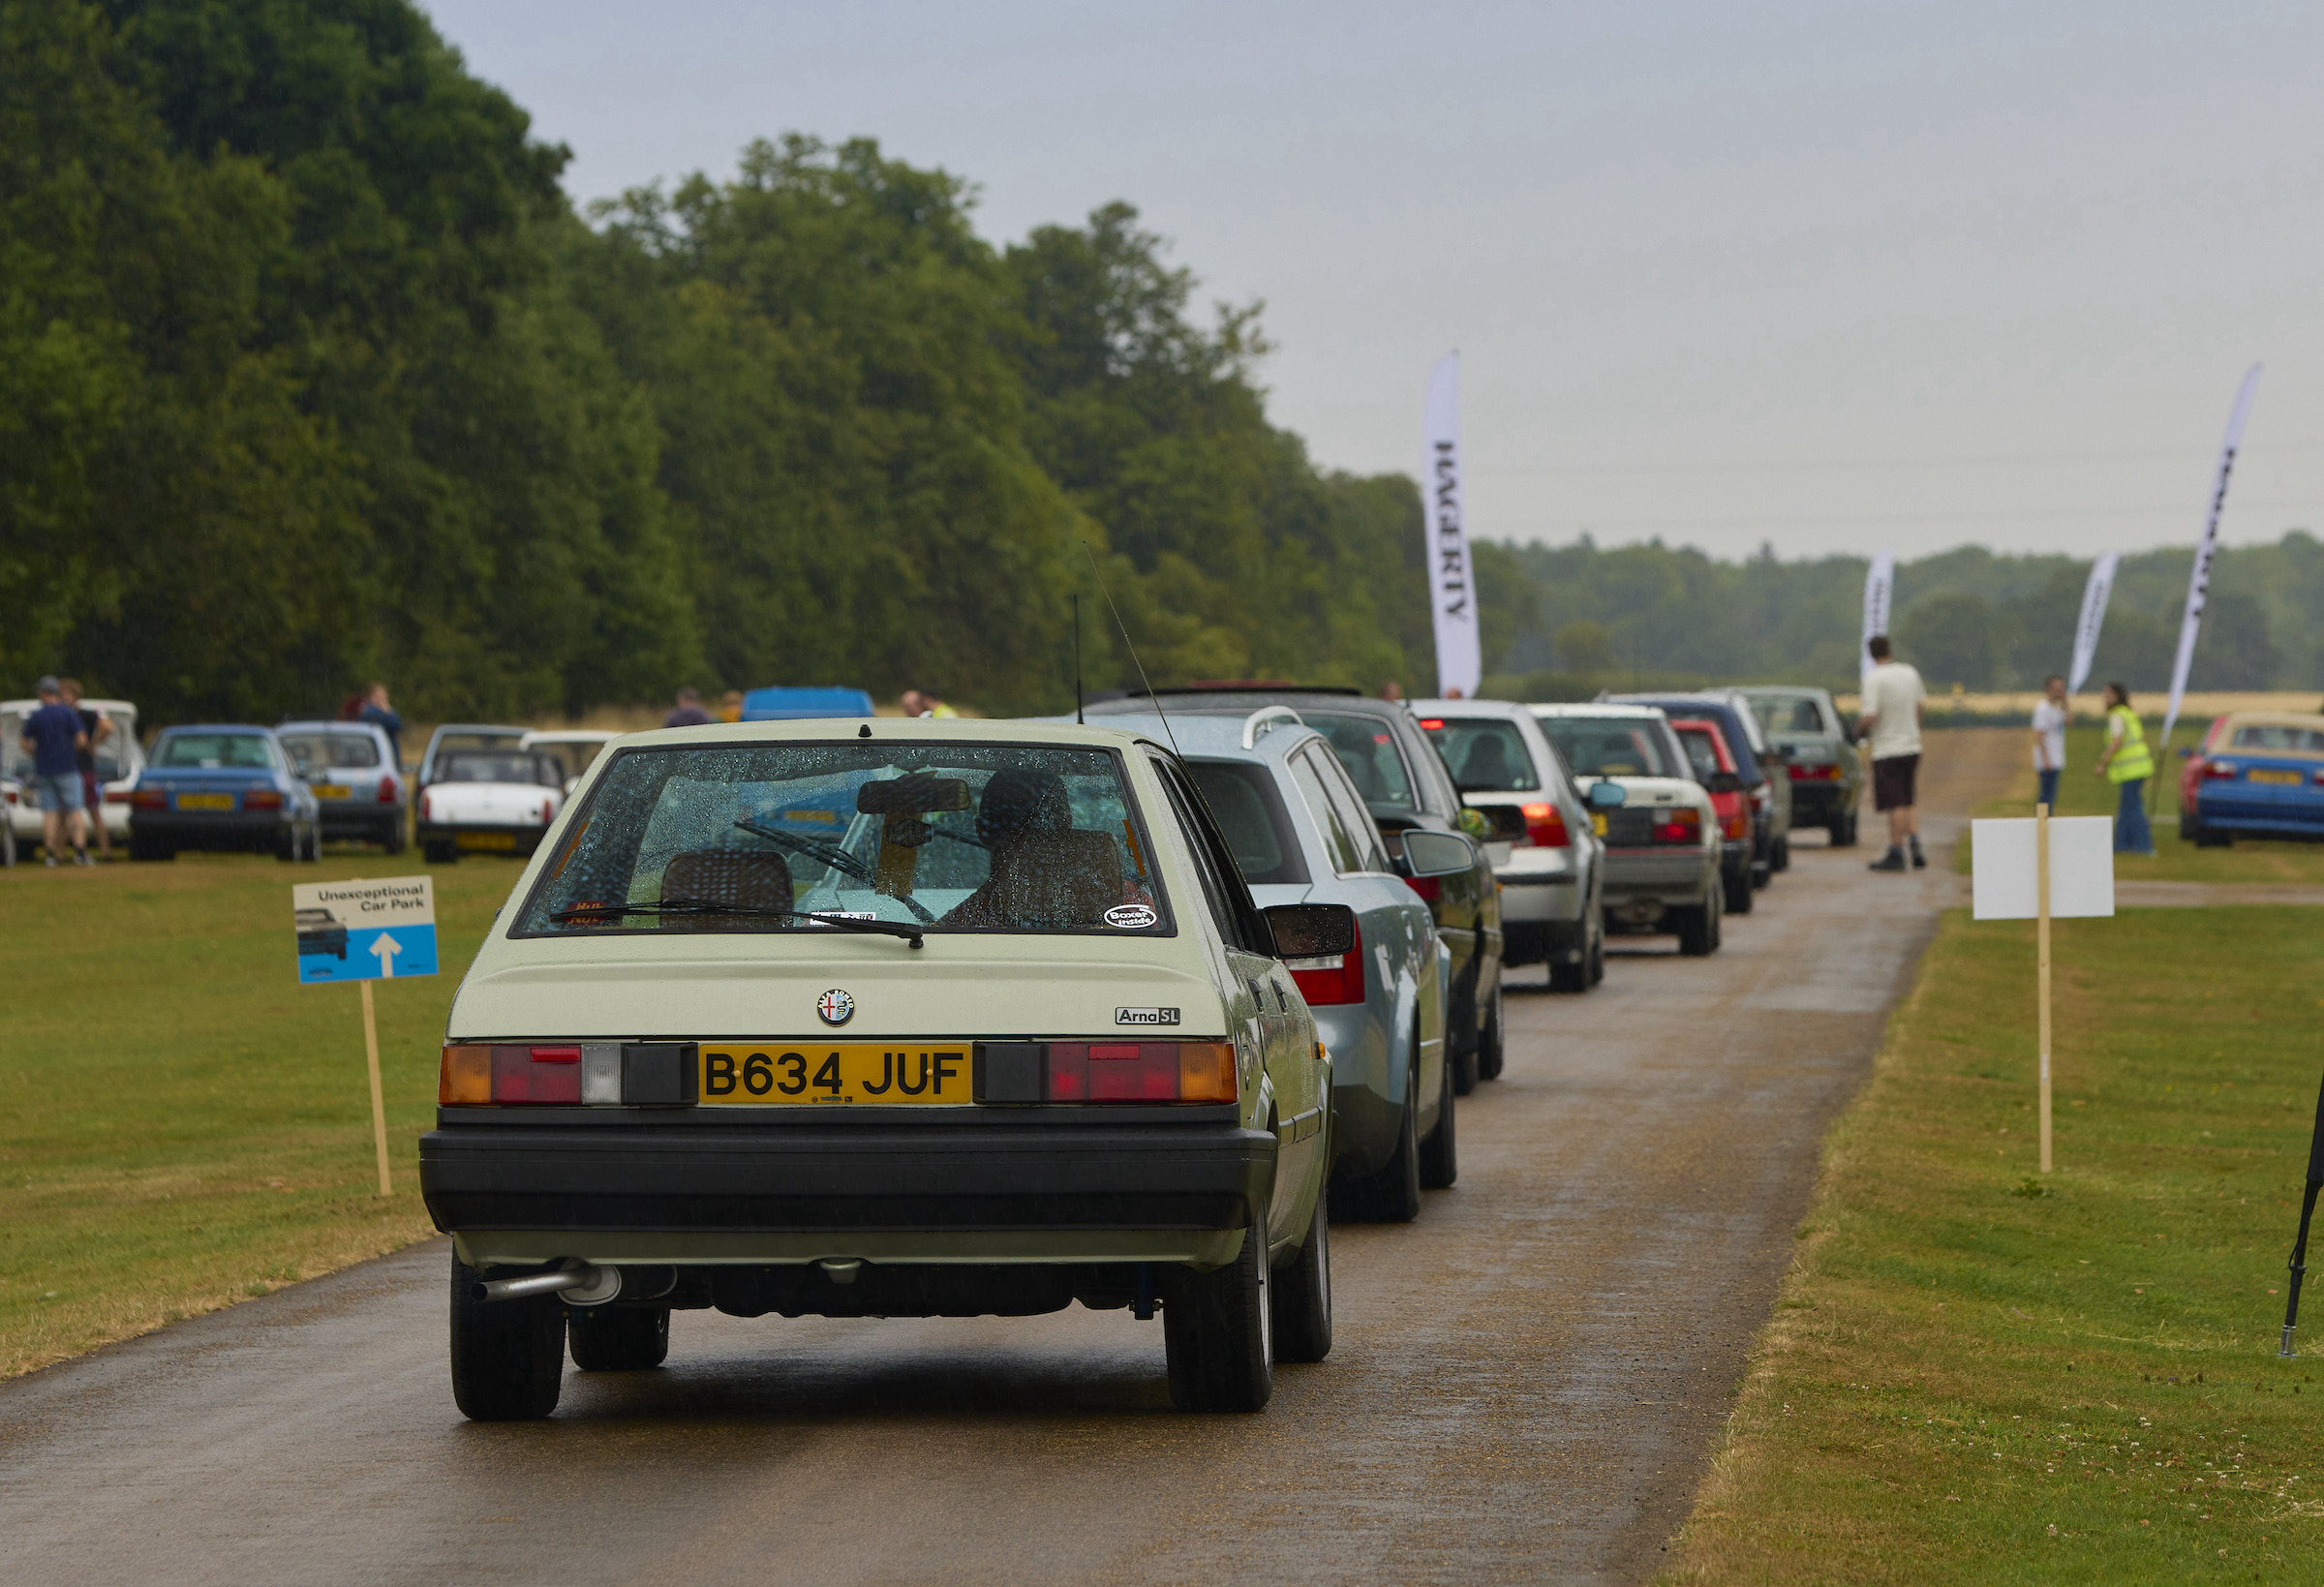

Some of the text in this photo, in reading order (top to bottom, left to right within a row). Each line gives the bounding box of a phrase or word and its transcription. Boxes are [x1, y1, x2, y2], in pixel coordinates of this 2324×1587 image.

[1435, 439, 1469, 623] HAGERTY
[319, 883, 424, 901] Unexceptional
[360, 898, 425, 912] Car Park
[1110, 911, 1148, 920] Boxer
[817, 990, 854, 1009] ALFA ROMEO
[1118, 1009, 1157, 1022] Arna
[705, 1052, 964, 1095] B634 JUF
